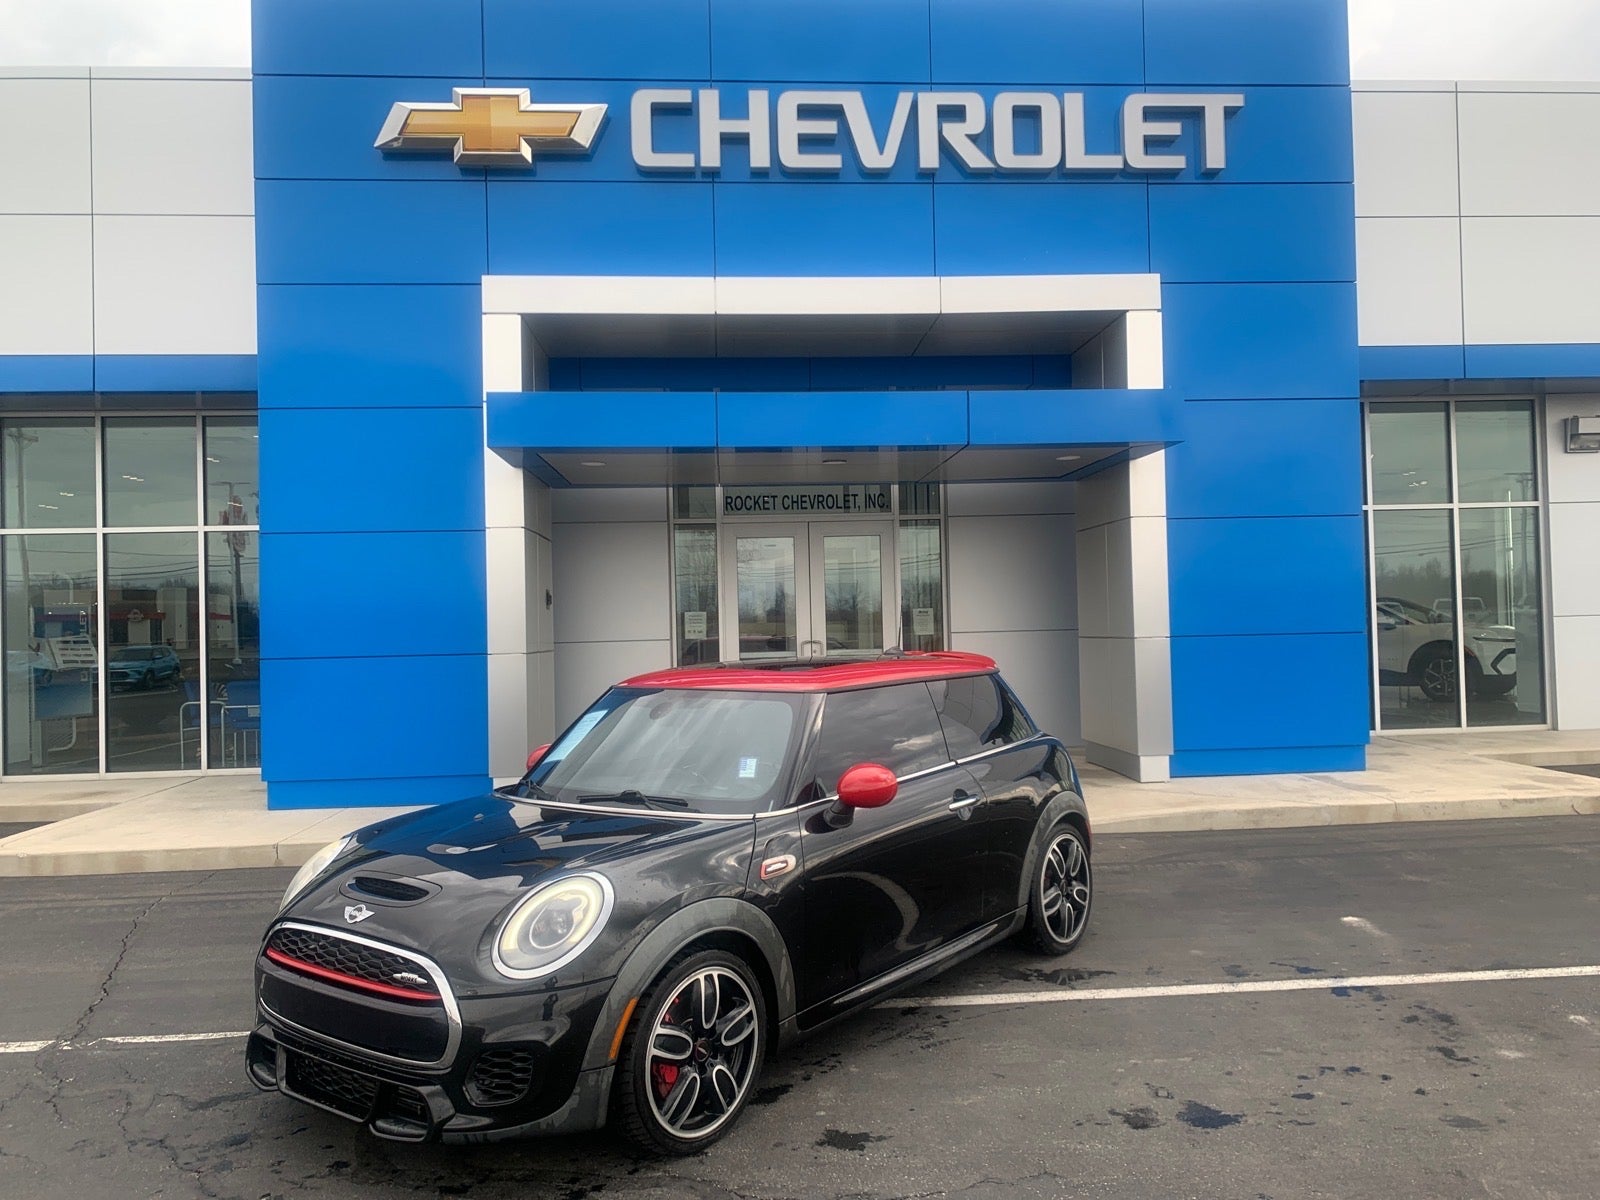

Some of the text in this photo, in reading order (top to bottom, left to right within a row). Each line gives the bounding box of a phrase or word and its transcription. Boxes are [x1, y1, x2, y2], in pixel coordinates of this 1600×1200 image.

[630, 88, 1246, 171] CHEVROLET
[725, 493, 889, 512] ROCKET CHEVROLET, INC.
